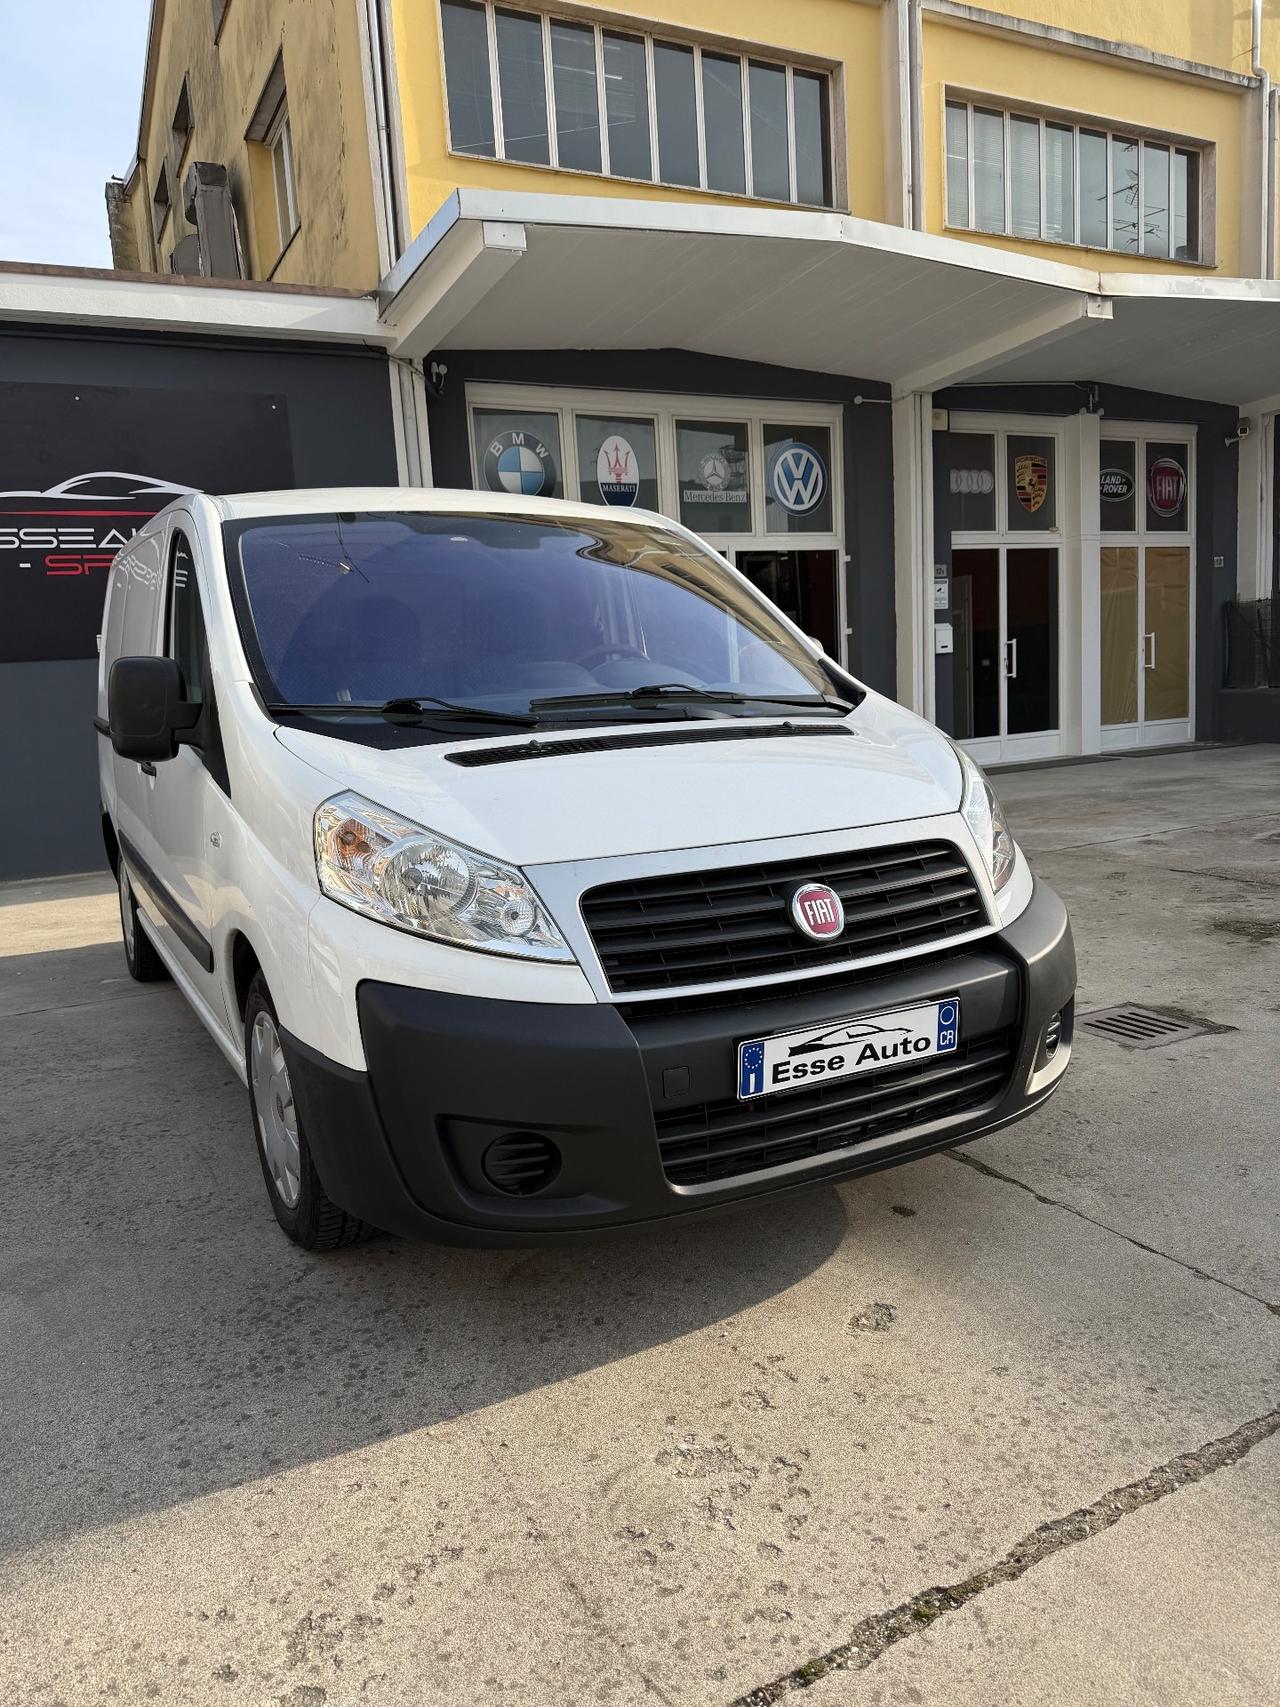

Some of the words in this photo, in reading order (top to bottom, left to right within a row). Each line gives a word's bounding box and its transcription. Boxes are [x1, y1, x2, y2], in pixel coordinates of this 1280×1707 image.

[490, 432, 549, 458] BMW
[602, 484, 636, 493] MASERATI
[1101, 475, 1122, 484] LAND
[1102, 484, 1128, 494] ROVER
[1156, 475, 1179, 500] FIAT
[804, 899, 836, 926] FIAT
[940, 1029, 954, 1045] CR
[771, 1053, 845, 1085] Esse
[855, 1036, 932, 1066] Auto
